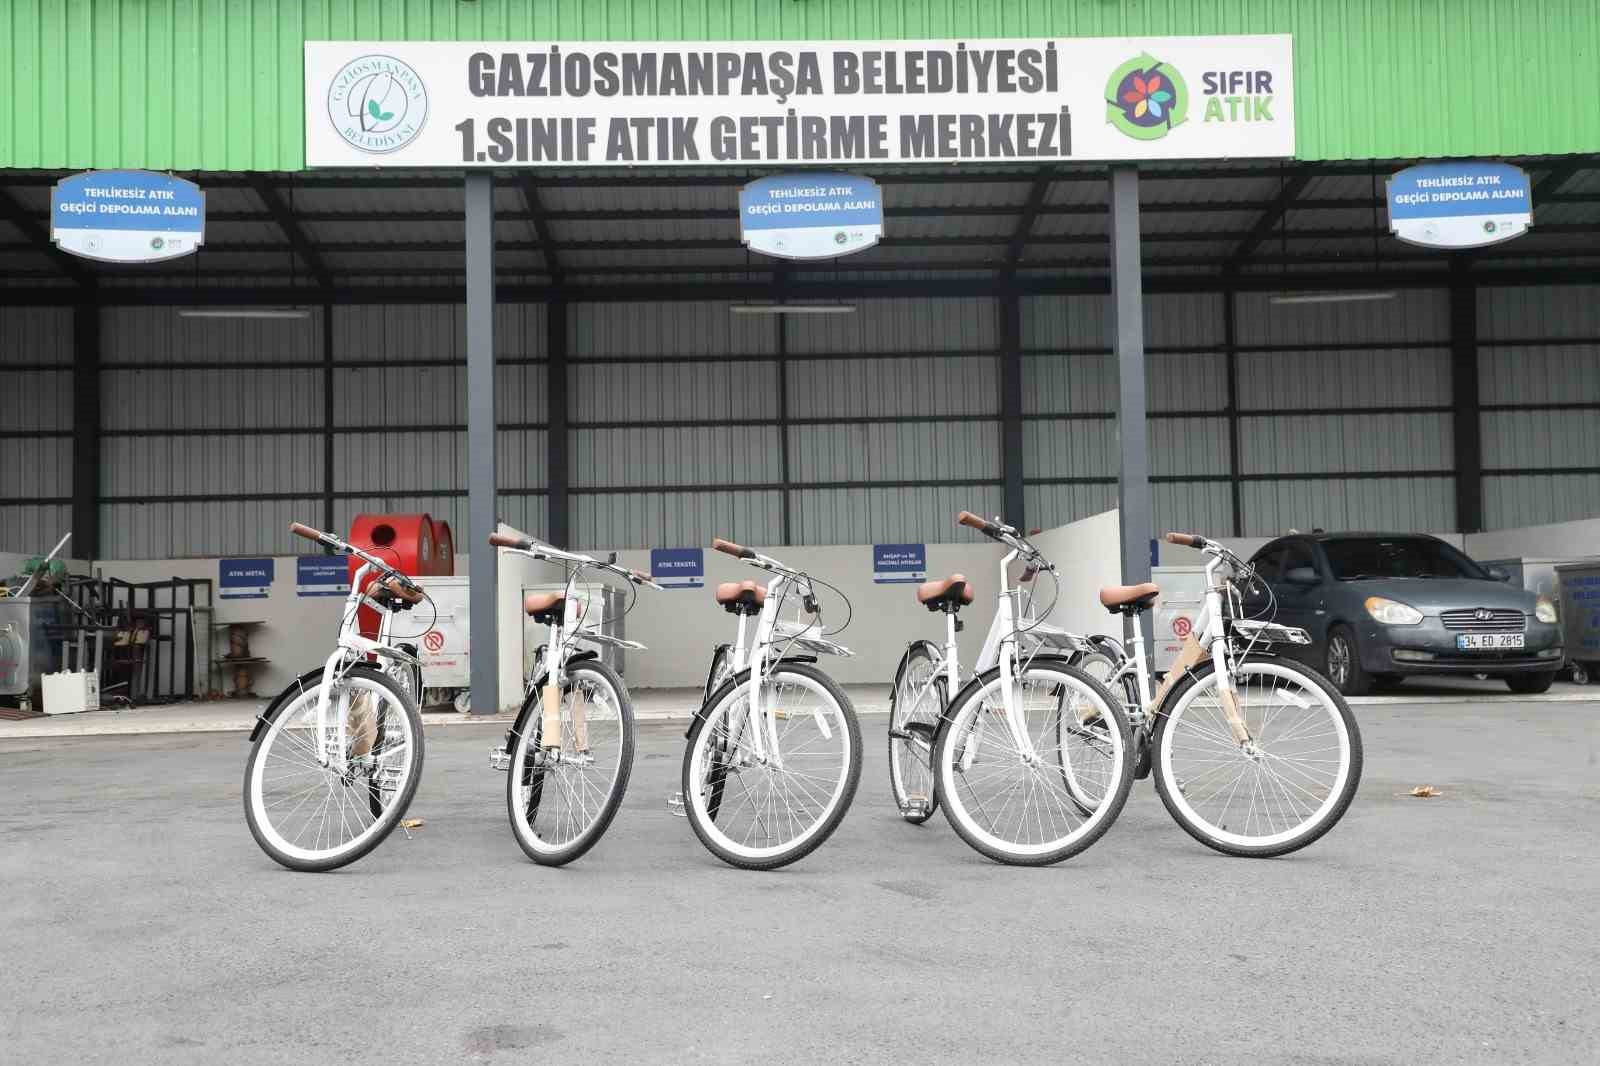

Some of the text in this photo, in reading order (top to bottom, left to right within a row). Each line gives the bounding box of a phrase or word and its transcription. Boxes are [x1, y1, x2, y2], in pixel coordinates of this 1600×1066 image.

[468, 41, 1058, 104] GAZİOSMANPAŞA BELEDİYESİ
[1202, 70, 1273, 95] SIFIR
[1203, 96, 1274, 122] ATIK
[455, 105, 1072, 162] 1.SINIF ATIK GETİRME MERKEZİ
[1416, 174, 1474, 188] TEHLİKESİZ
[84, 186, 174, 200] TEHLİKESİZ ATIK
[769, 185, 853, 199] TEHLİKESİZ ATIK
[1431, 192, 1489, 203] DEPOLAMA
[1491, 189, 1524, 199] ALANI
[60, 202, 198, 217] GEÇİCİ DEPOLAMA ALANI
[784, 202, 841, 213] DEPOLAMA
[844, 199, 876, 210] ALANI
[1501, 635, 1523, 647] 2815
